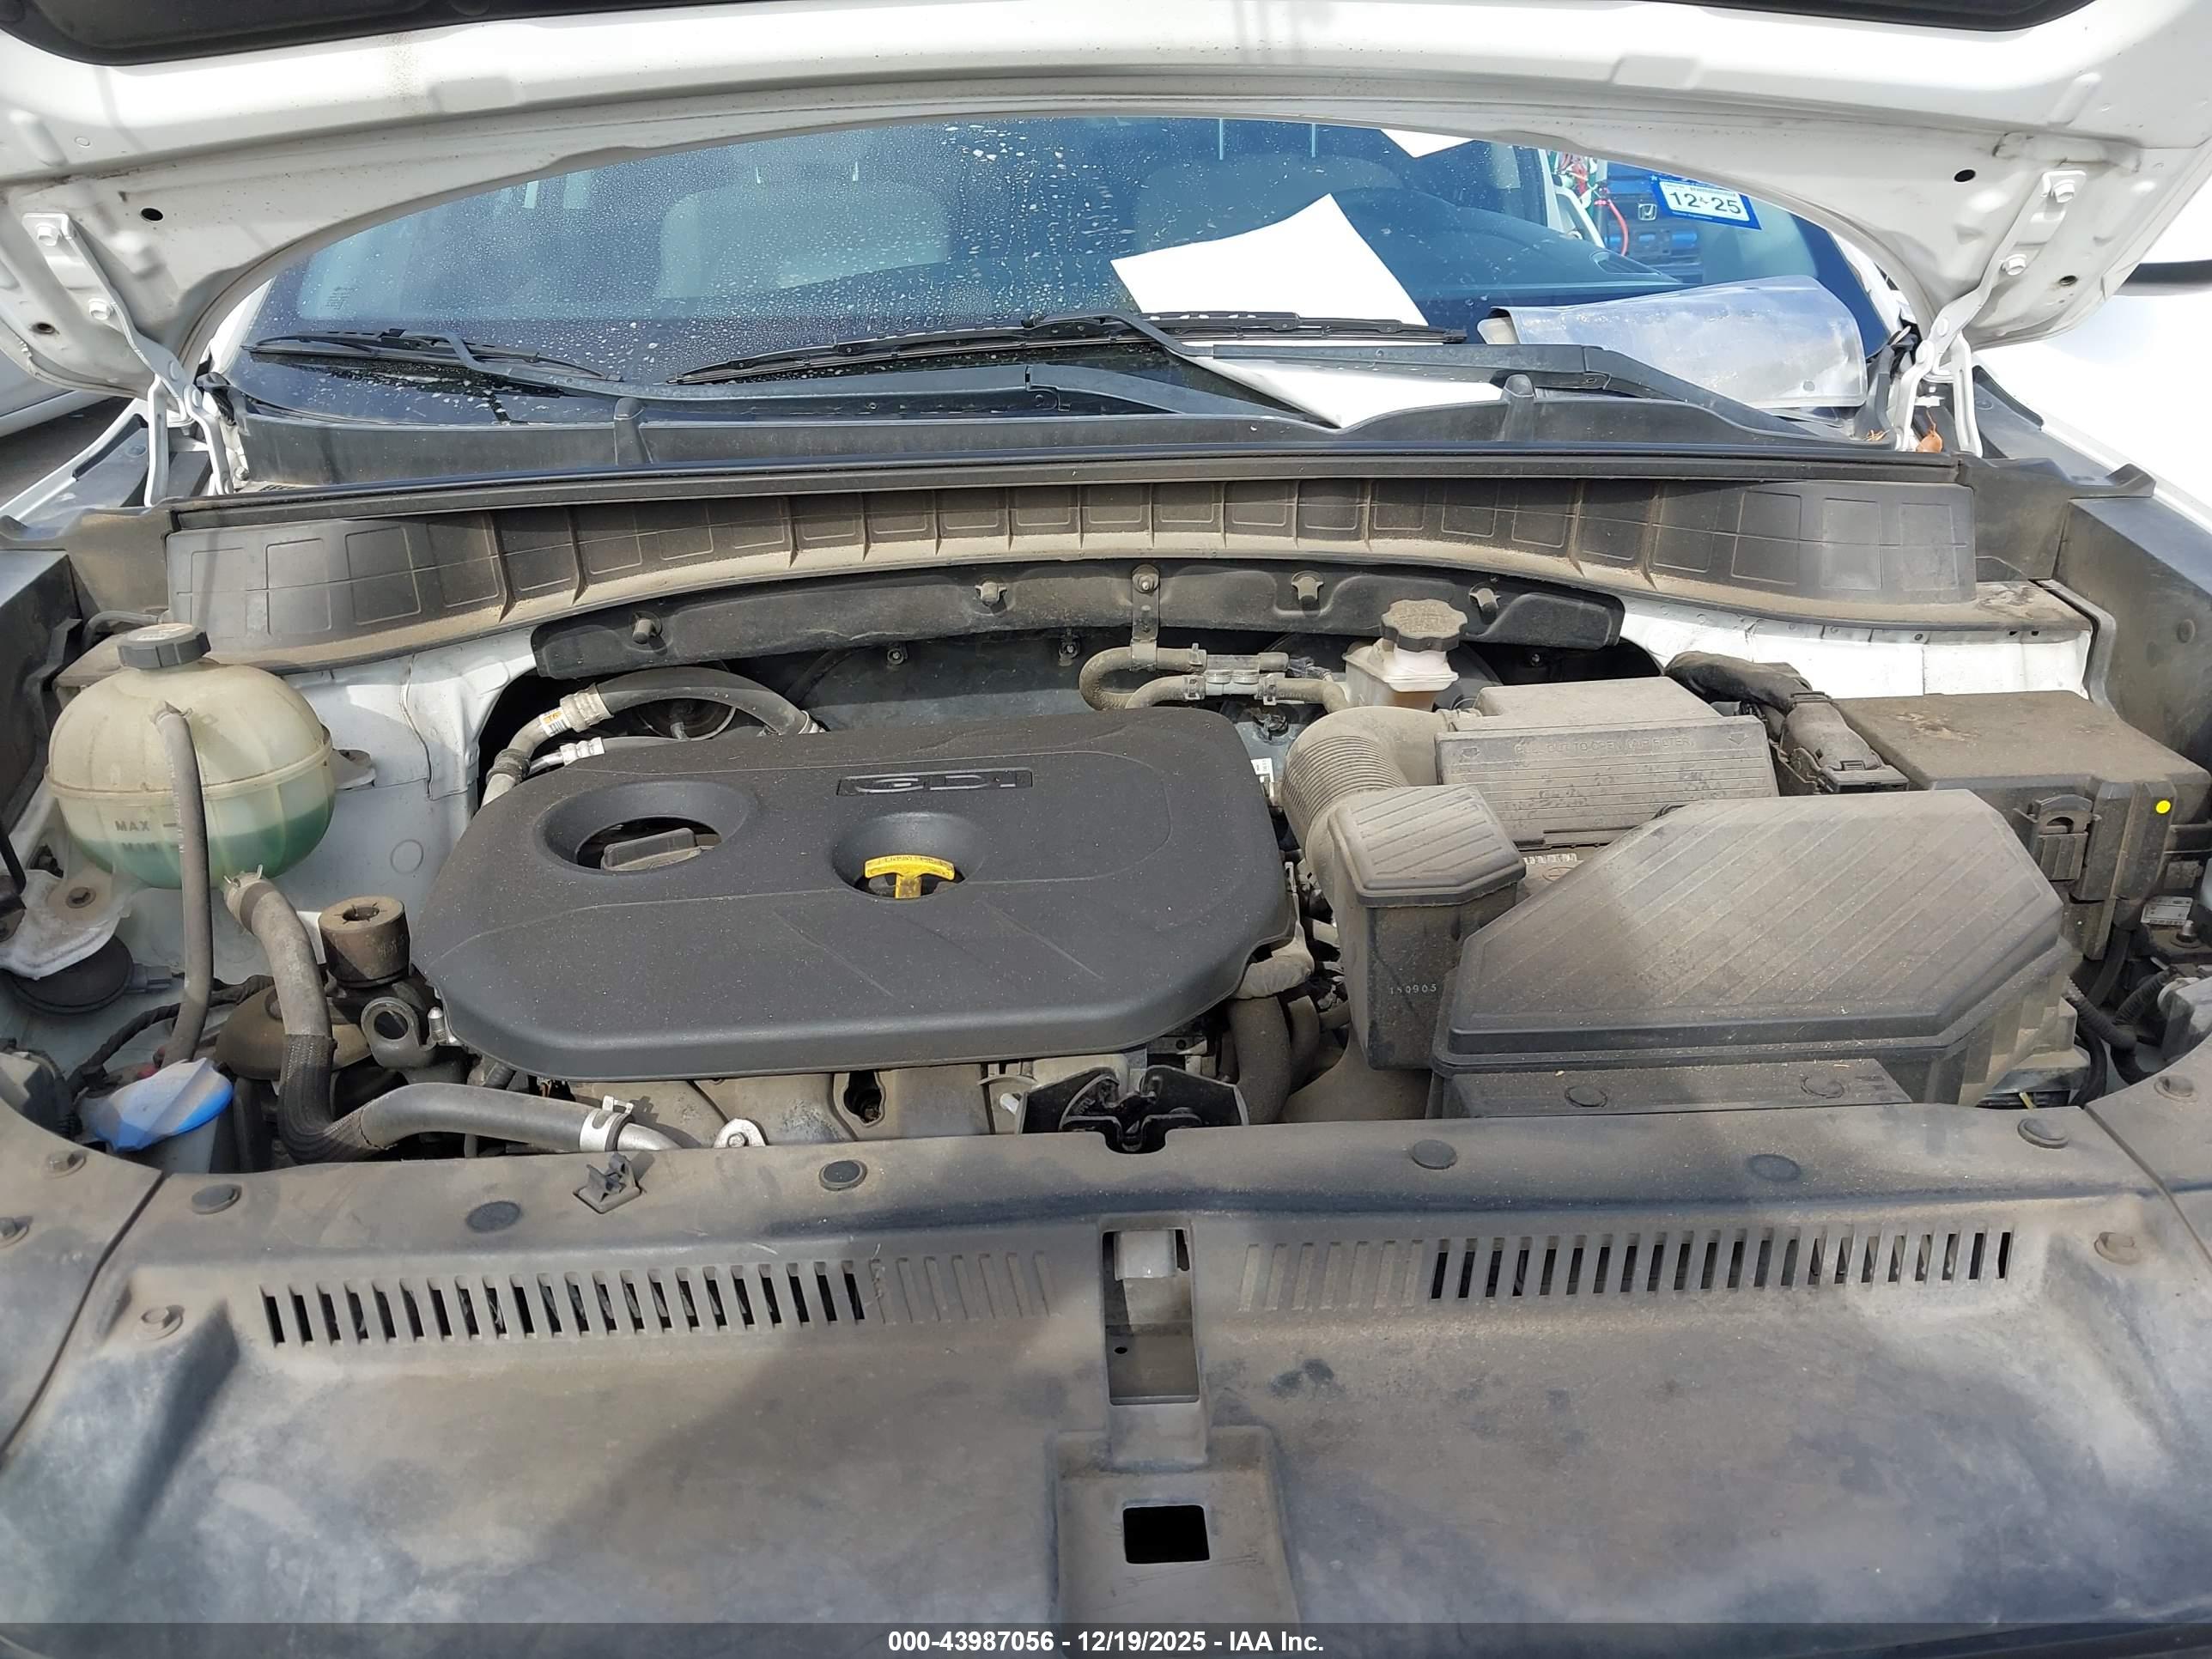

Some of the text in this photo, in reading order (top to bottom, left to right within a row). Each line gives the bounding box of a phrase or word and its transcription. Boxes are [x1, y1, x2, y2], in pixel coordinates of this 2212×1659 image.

[1669, 191, 1741, 214] 12 25
[1572, 741, 1589, 752] TO
[114, 820, 150, 832] MAX
